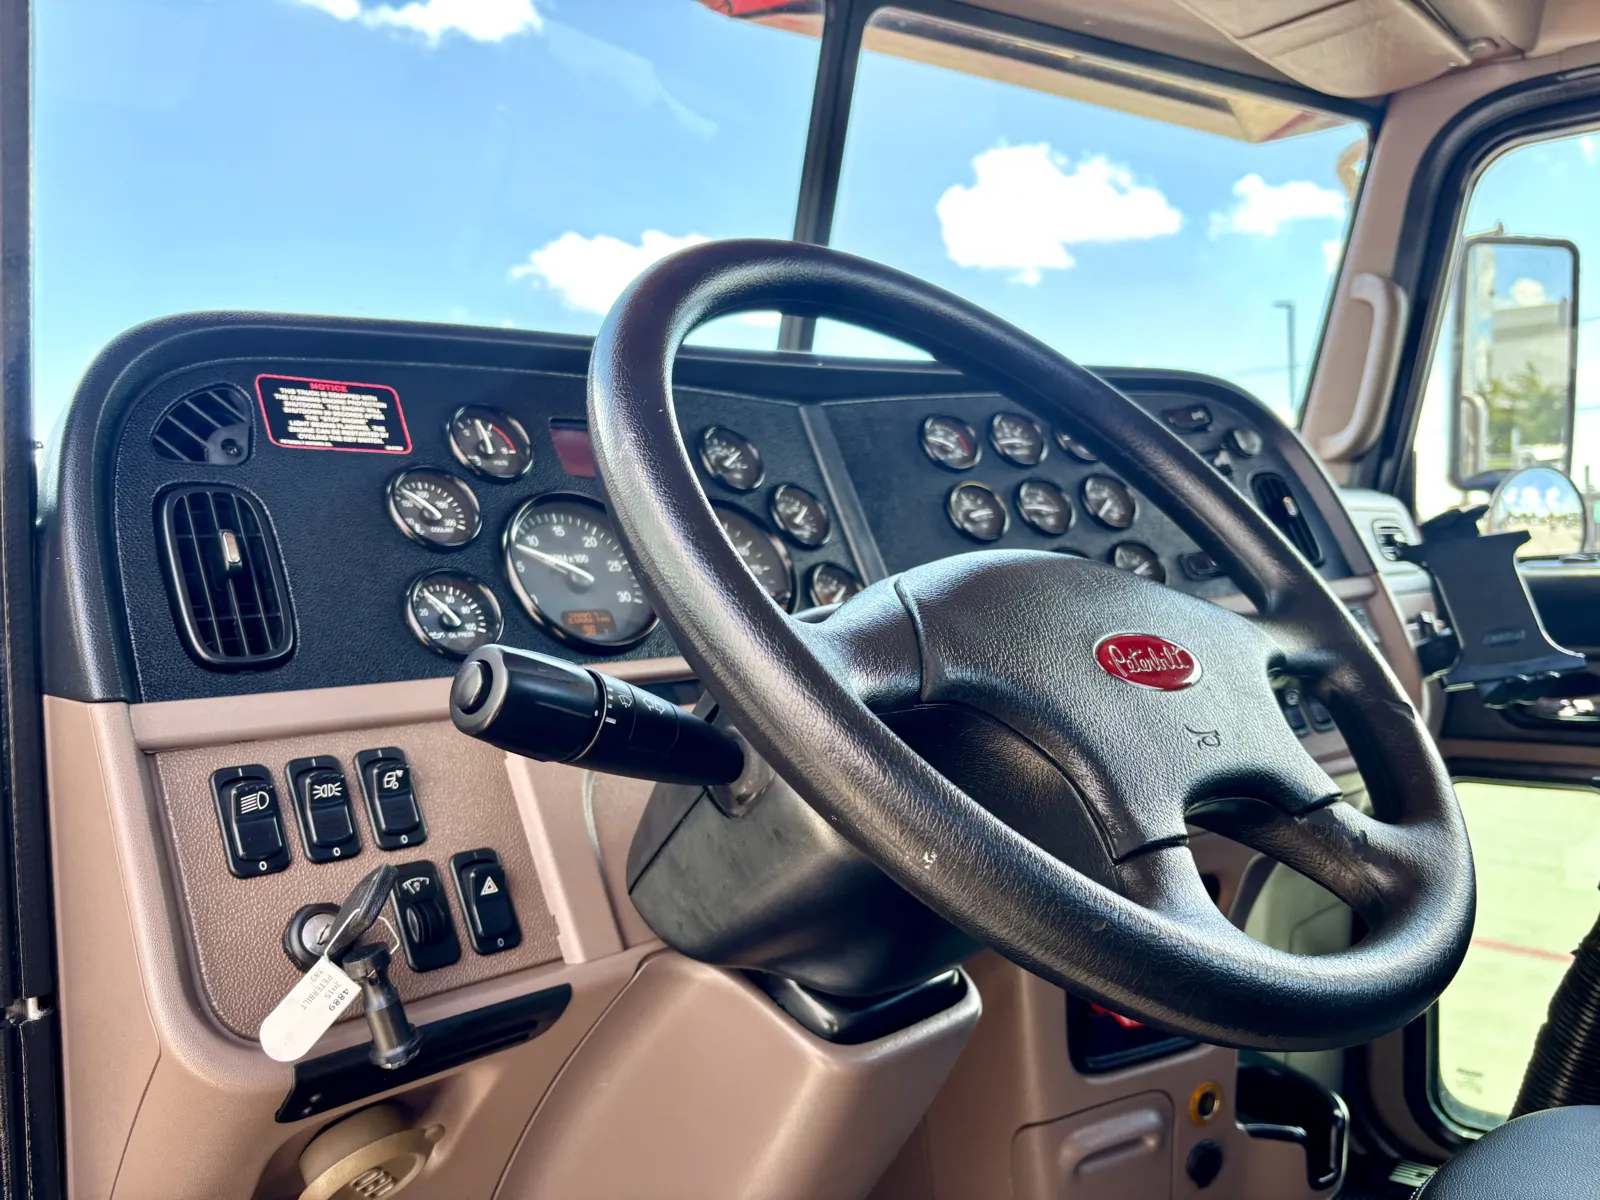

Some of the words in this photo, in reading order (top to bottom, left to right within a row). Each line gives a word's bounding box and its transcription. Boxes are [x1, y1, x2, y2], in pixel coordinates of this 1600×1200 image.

[310, 383, 348, 393] NOTICE
[297, 389, 320, 397] TRUCK
[328, 391, 361, 400] EQUIPPED
[346, 400, 387, 408] PROTECTION
[283, 407, 323, 415] SHUTDOWN
[297, 433, 329, 441] CYCLING
[552, 525, 566, 537] 15
[526, 534, 540, 547] 10
[583, 536, 598, 548] 20
[516, 561, 525, 573] 5
[607, 560, 622, 572] 25
[617, 591, 632, 603] 30
[420, 608, 429, 617] 20
[1108, 645, 1189, 677] Peterbilt
[300, 974, 334, 1011] PETERBILT
[324, 980, 342, 999] 2015
[328, 988, 349, 1012] 4889
